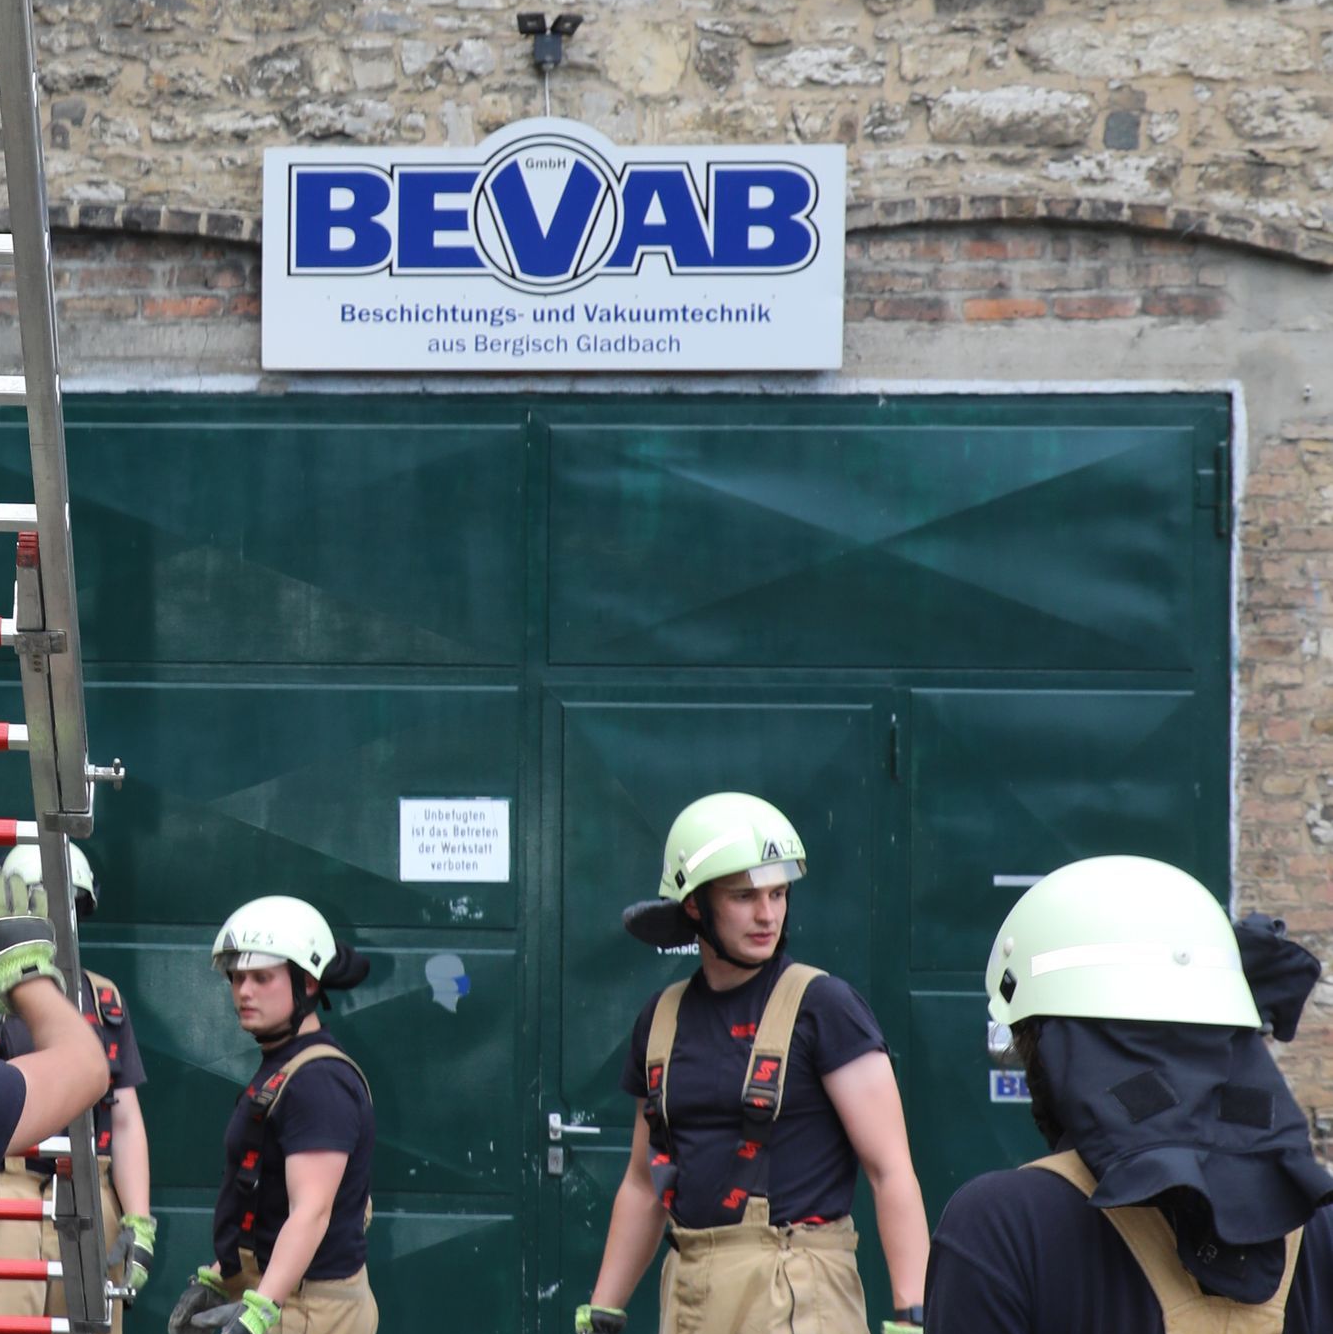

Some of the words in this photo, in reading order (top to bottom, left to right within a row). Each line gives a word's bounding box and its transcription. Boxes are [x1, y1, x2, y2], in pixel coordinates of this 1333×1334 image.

[525, 156, 568, 170] GmbH
[287, 157, 820, 277] BEVAB
[340, 302, 525, 325] Beschichtungs-
[532, 302, 576, 323] und
[585, 302, 771, 323] Vakuumtechnik
[427, 337, 467, 353] aus
[474, 334, 569, 358] Bergisch
[577, 334, 681, 354] Gladbach
[424, 808, 485, 824] Unbefugten
[411, 826, 425, 837] ist
[429, 826, 448, 837] das
[453, 826, 498, 837] Betreten
[418, 843, 435, 854] der
[441, 843, 492, 854] Werkstatt
[431, 859, 478, 871] verboten
